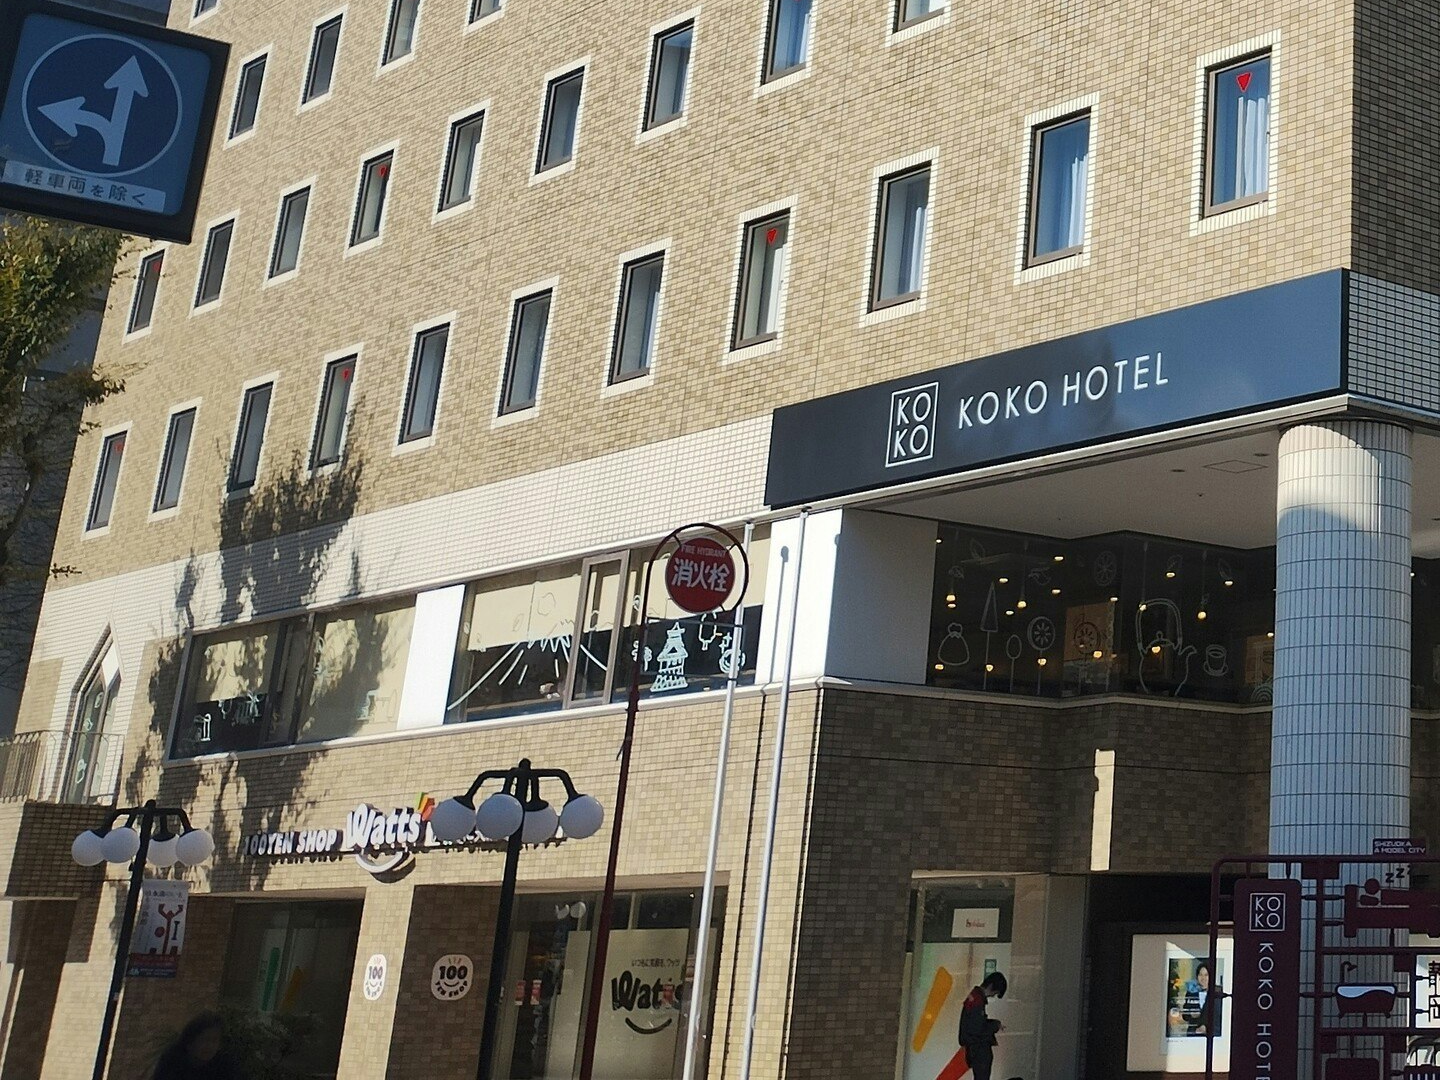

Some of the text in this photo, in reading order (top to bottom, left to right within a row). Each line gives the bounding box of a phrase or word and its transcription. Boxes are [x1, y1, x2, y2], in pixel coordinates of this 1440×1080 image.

[24, 167, 147, 206] 軽車両を除く
[958, 352, 1169, 429] KOKO HOTEL
[897, 392, 931, 426] KO
[893, 424, 929, 458] KO
[671, 557, 730, 592] 消火栓
[296, 829, 338, 854] SHOP
[346, 803, 421, 849] Watts
[1255, 897, 1281, 911] KO
[1255, 913, 1281, 928] KO
[368, 965, 383, 980] 100
[439, 965, 468, 980] 100
[1255, 942, 1274, 1080] KOKO HOT
